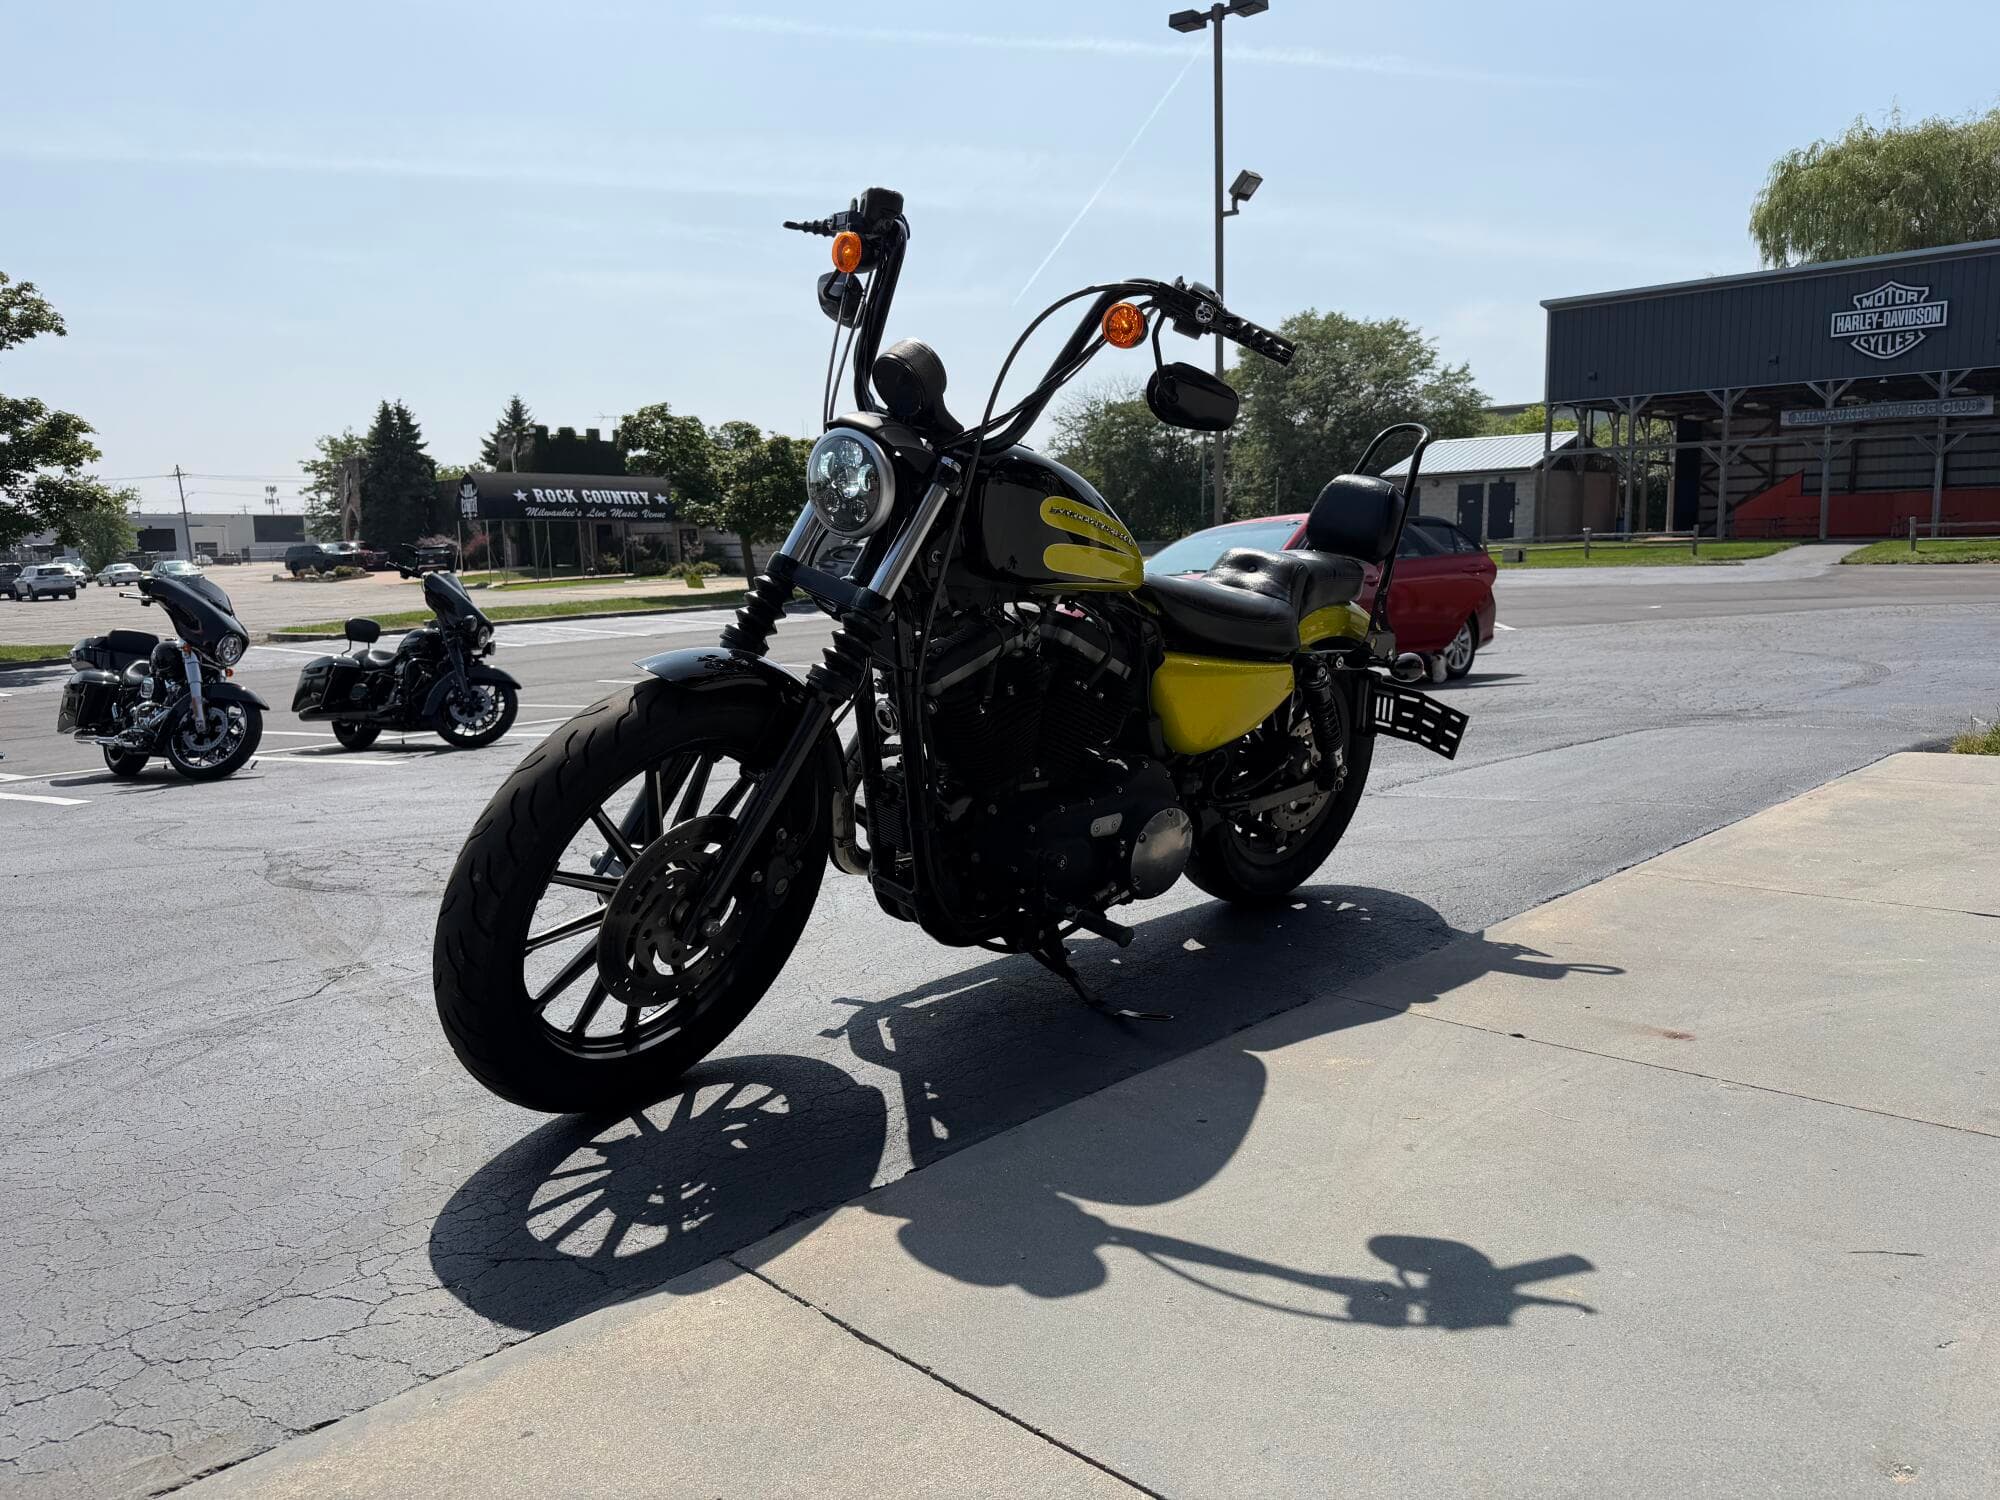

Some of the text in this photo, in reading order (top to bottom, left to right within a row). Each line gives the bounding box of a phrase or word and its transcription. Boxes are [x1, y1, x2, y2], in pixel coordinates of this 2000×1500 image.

[1862, 287, 1918, 308] MOTOR
[1836, 306, 1942, 333] HARLEY-DAVIDSON
[1860, 331, 1915, 355] CYCLES
[1907, 403, 1937, 415] HOG
[1942, 400, 1978, 413] CLUB
[532, 488, 651, 505] ROCK COUNTRY
[525, 506, 667, 518] Milwaukee's Live Music Venue
